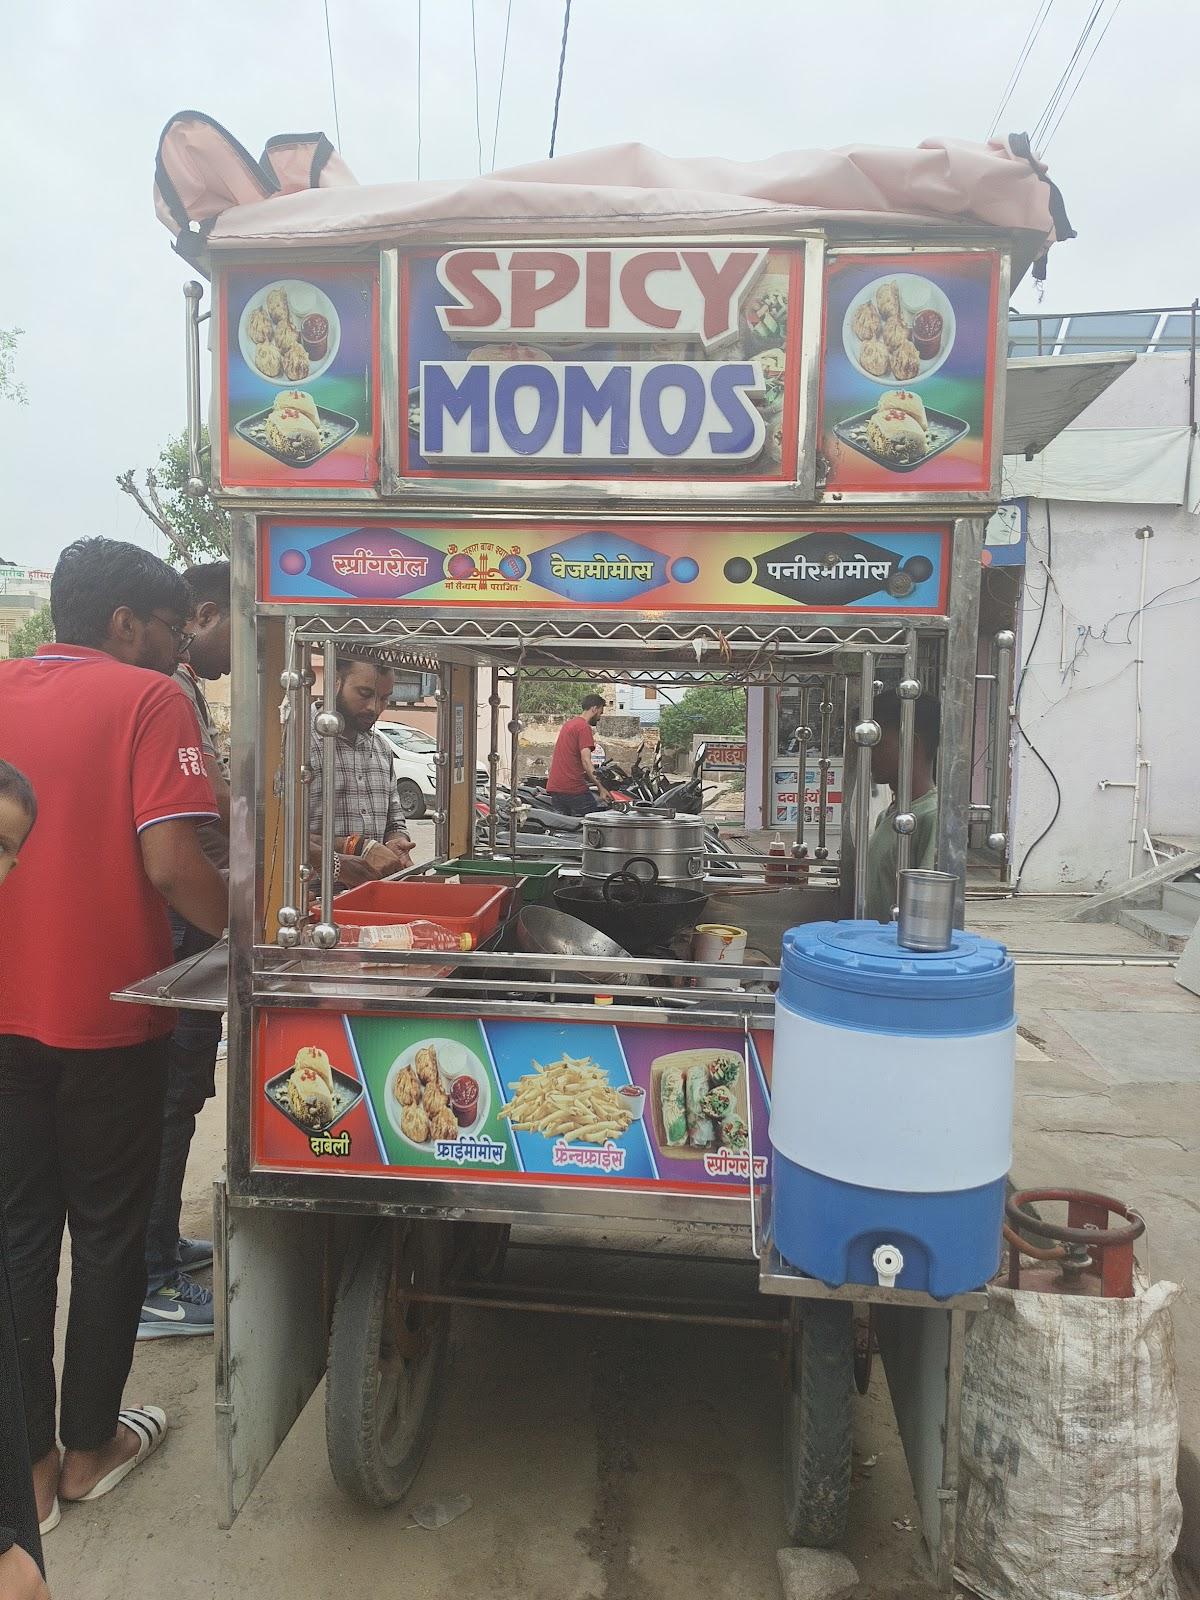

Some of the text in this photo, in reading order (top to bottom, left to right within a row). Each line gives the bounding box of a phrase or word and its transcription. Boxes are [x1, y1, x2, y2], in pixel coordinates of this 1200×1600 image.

[444, 250, 759, 341] SPICY
[424, 363, 756, 456] MOMOS
[550, 552, 655, 581] वेजमोमोस
[309, 1131, 351, 1156] दाबेली
